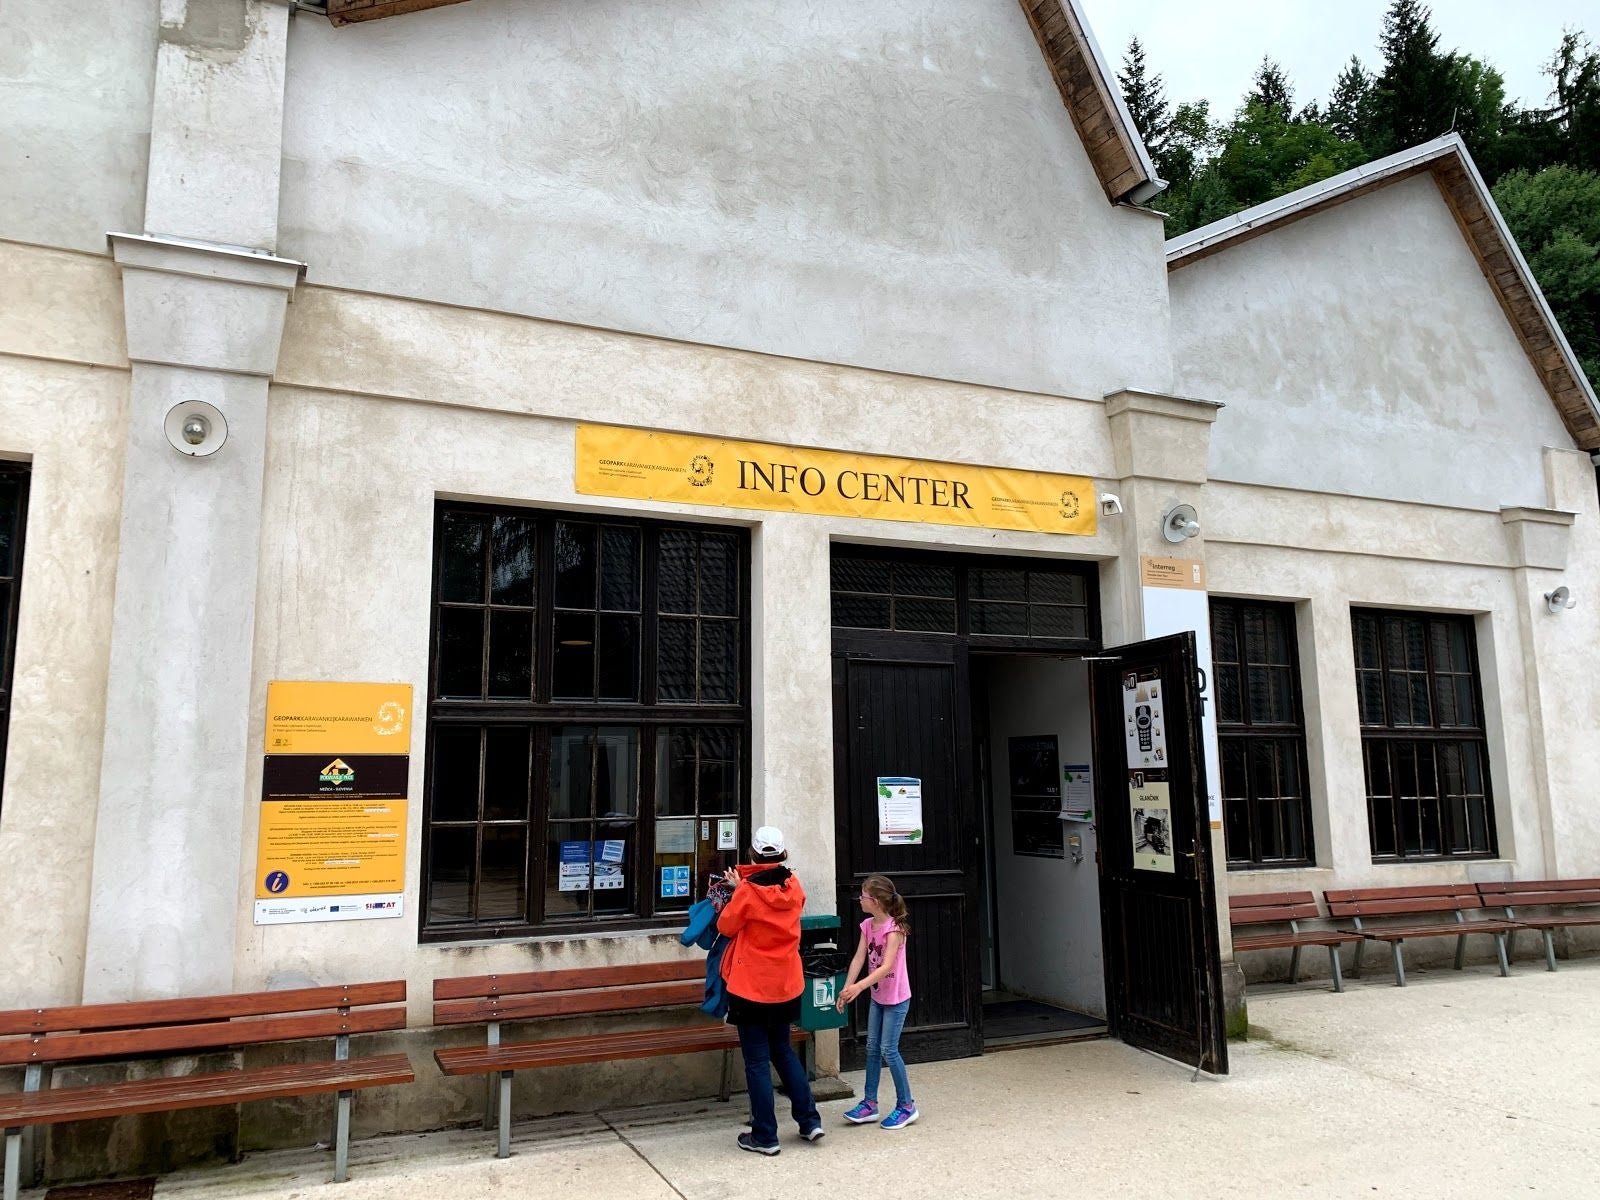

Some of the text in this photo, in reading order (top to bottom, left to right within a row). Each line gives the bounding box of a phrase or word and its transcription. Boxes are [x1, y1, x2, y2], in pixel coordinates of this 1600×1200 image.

[737, 459, 974, 510] INFO CENTER
[1152, 563, 1176, 571] Interreg
